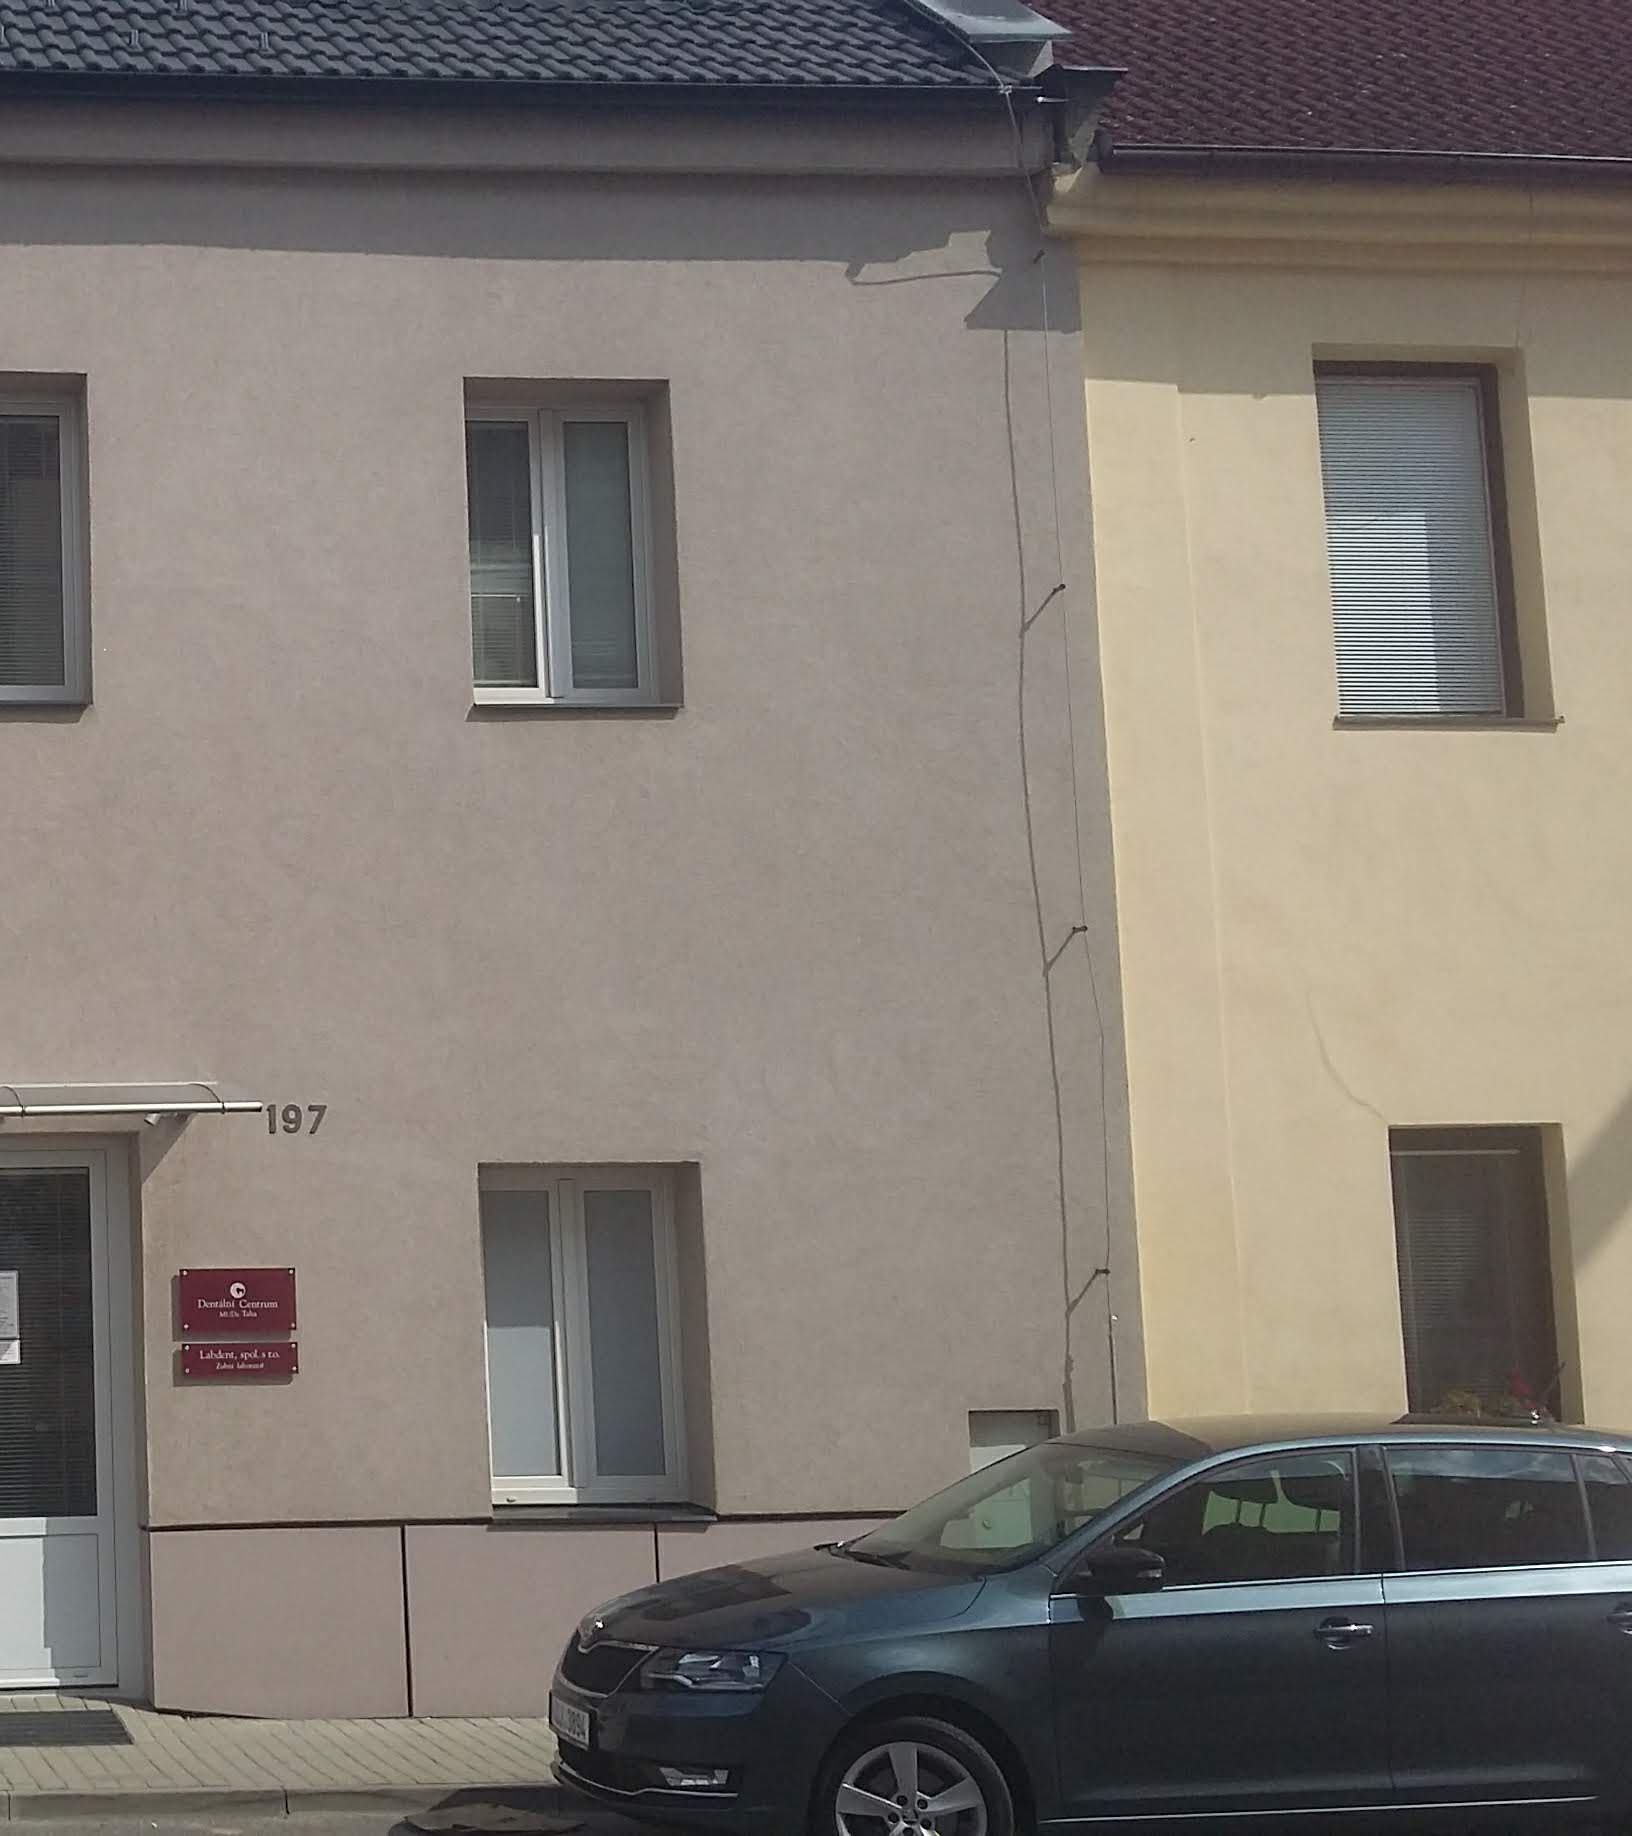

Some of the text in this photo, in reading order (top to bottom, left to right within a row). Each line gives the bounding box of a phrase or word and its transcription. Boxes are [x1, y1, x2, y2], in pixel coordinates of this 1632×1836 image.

[266, 1104, 327, 1134] 197
[198, 1299, 278, 1308] Dentální Centrum
[199, 1350, 238, 1359] Labdent,
